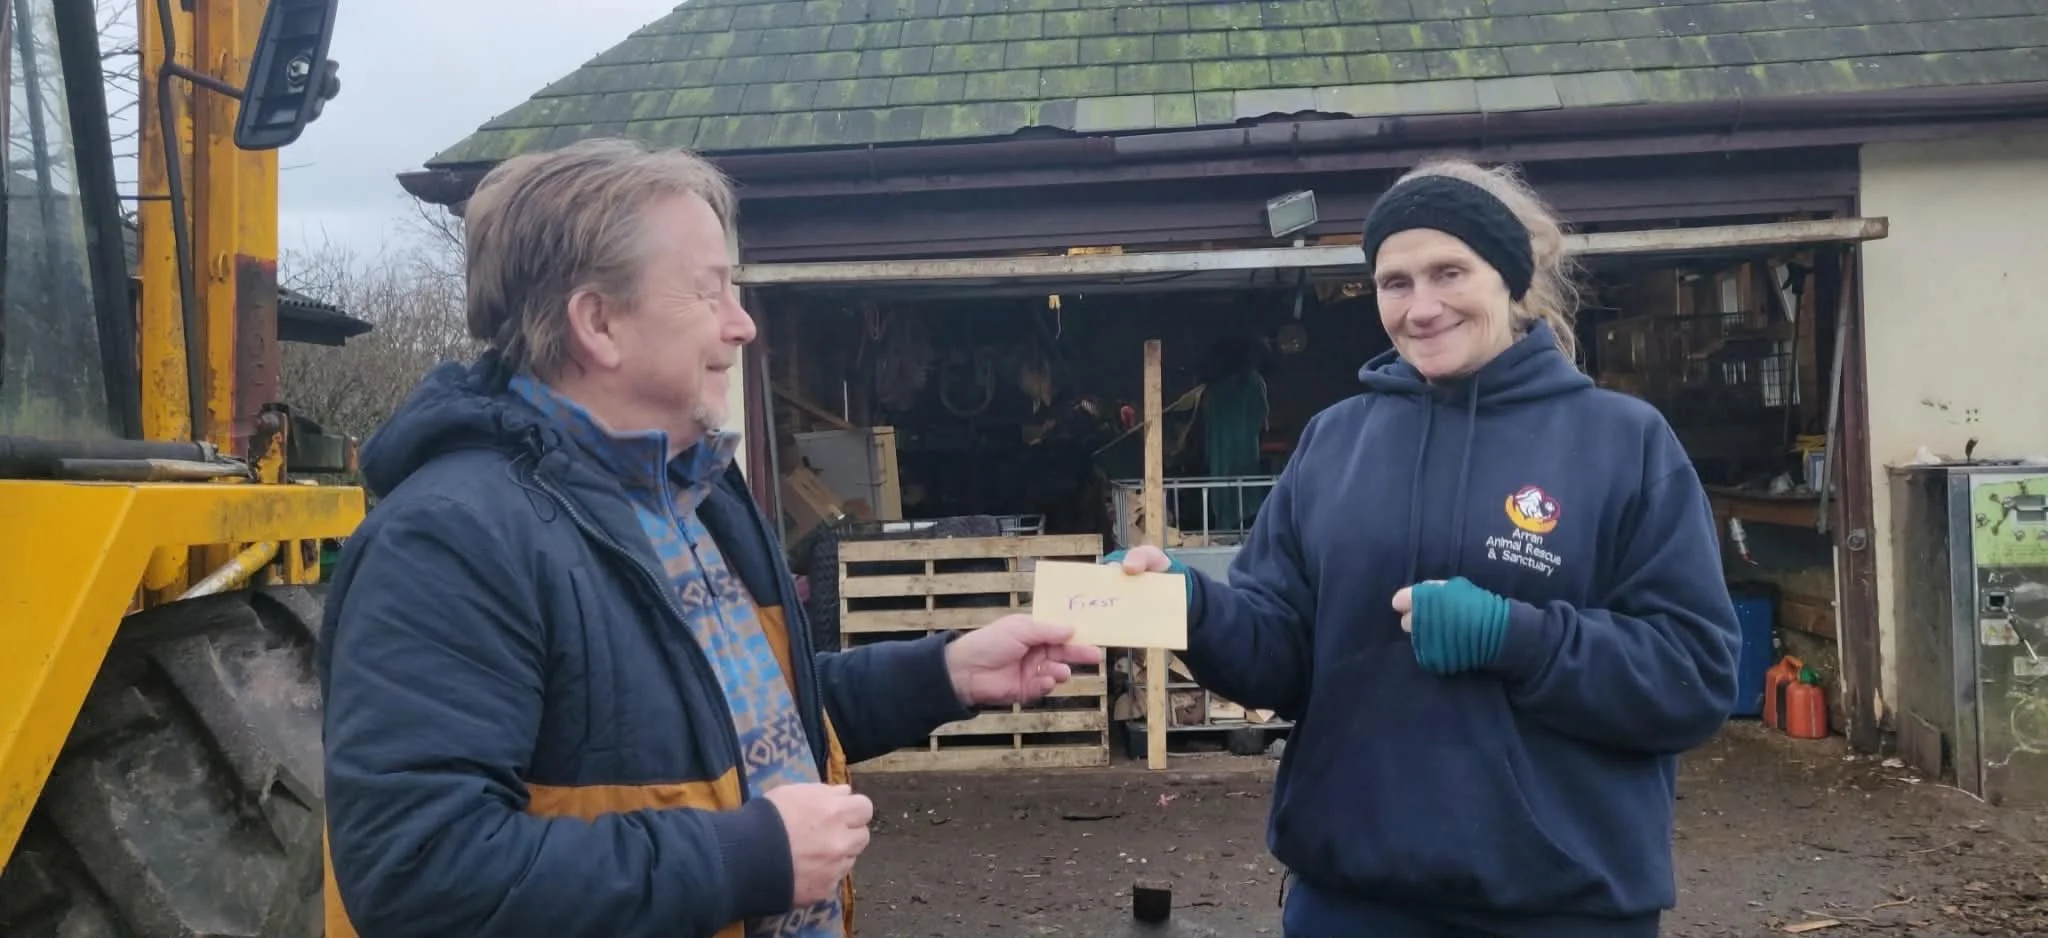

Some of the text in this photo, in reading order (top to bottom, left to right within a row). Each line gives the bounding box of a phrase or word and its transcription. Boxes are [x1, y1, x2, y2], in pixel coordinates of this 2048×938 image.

[1486, 536, 1561, 565] Animal Rescue
[1512, 528, 1543, 544] Arran
[1487, 547, 1553, 576] & Sanctuary
